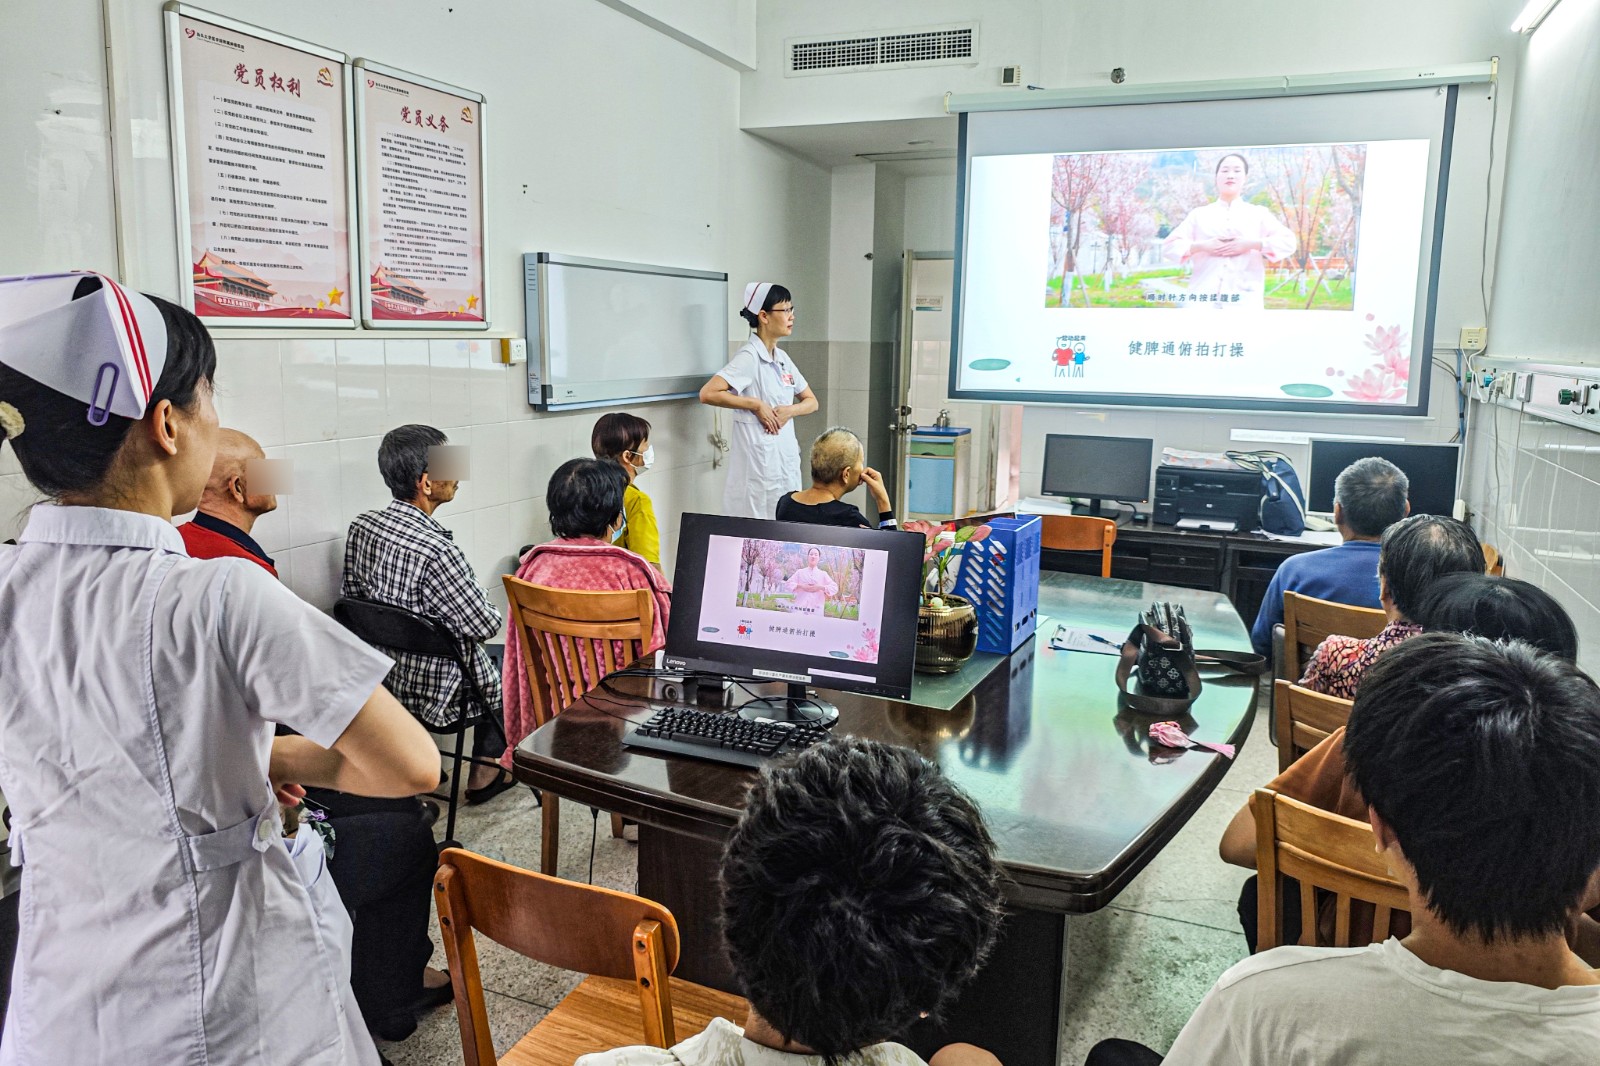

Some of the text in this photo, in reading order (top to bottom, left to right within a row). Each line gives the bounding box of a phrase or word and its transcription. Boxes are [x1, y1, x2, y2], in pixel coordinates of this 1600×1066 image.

[234, 63, 301, 98] 党员权利
[400, 106, 450, 133] 党员义务
[1128, 340, 1245, 358] 健脾通俯拍打操
[666, 658, 687, 666] Lenovo
